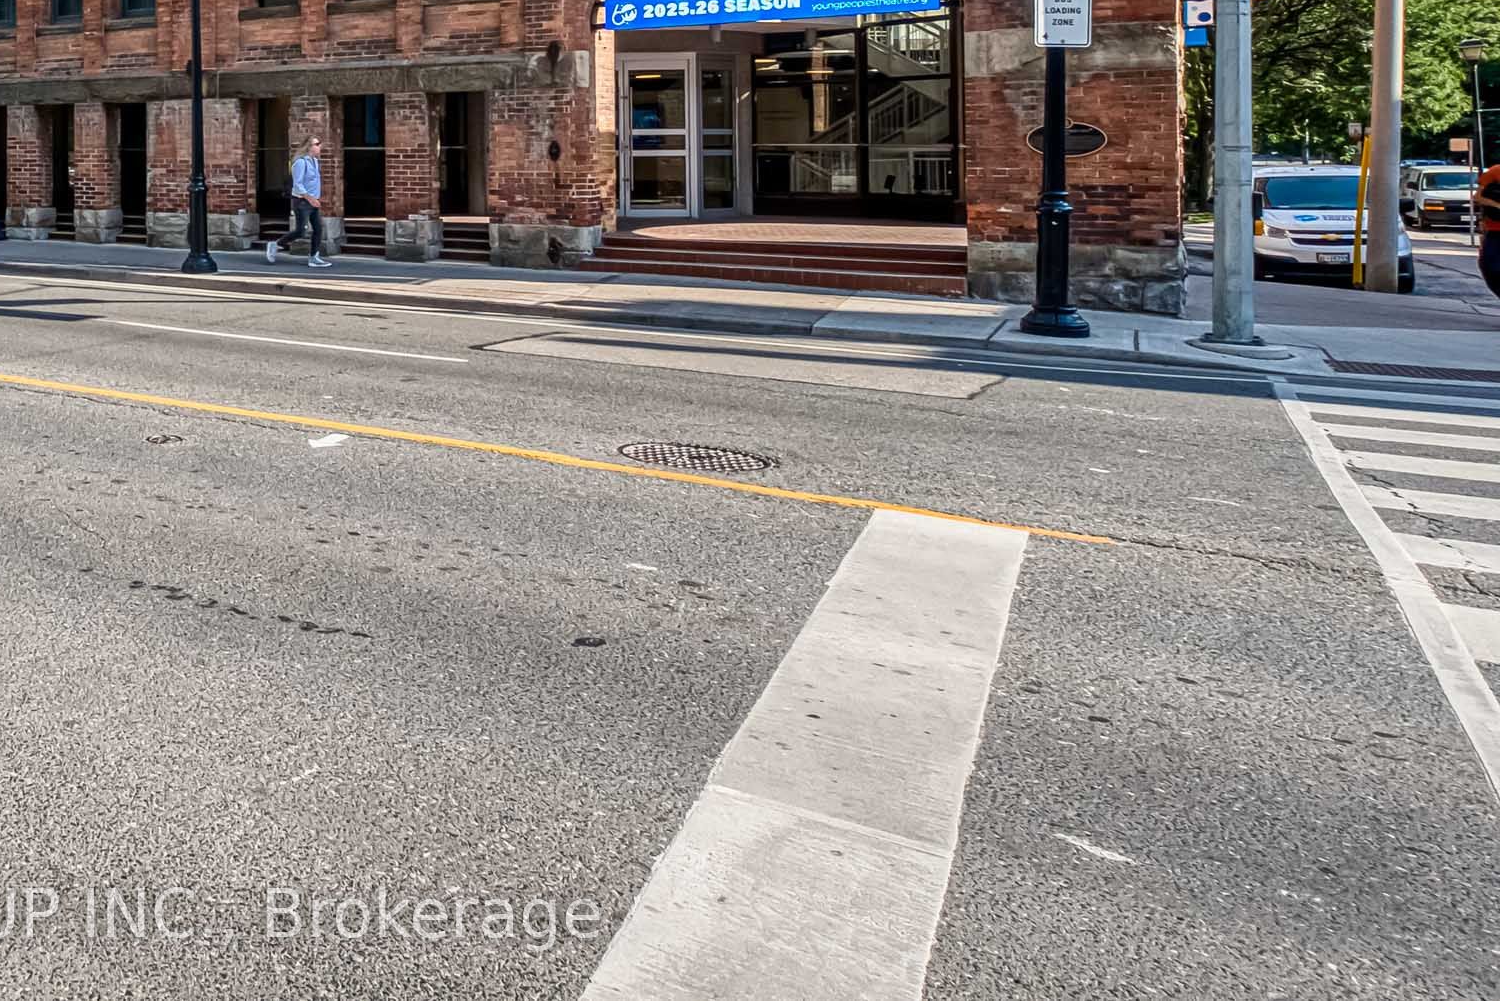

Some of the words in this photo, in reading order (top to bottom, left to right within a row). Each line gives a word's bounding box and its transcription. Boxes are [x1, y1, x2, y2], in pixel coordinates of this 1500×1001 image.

[643, 0, 719, 19] 2025.26
[1044, 7, 1082, 15] LOADING
[1051, 18, 1075, 26] ZONE
